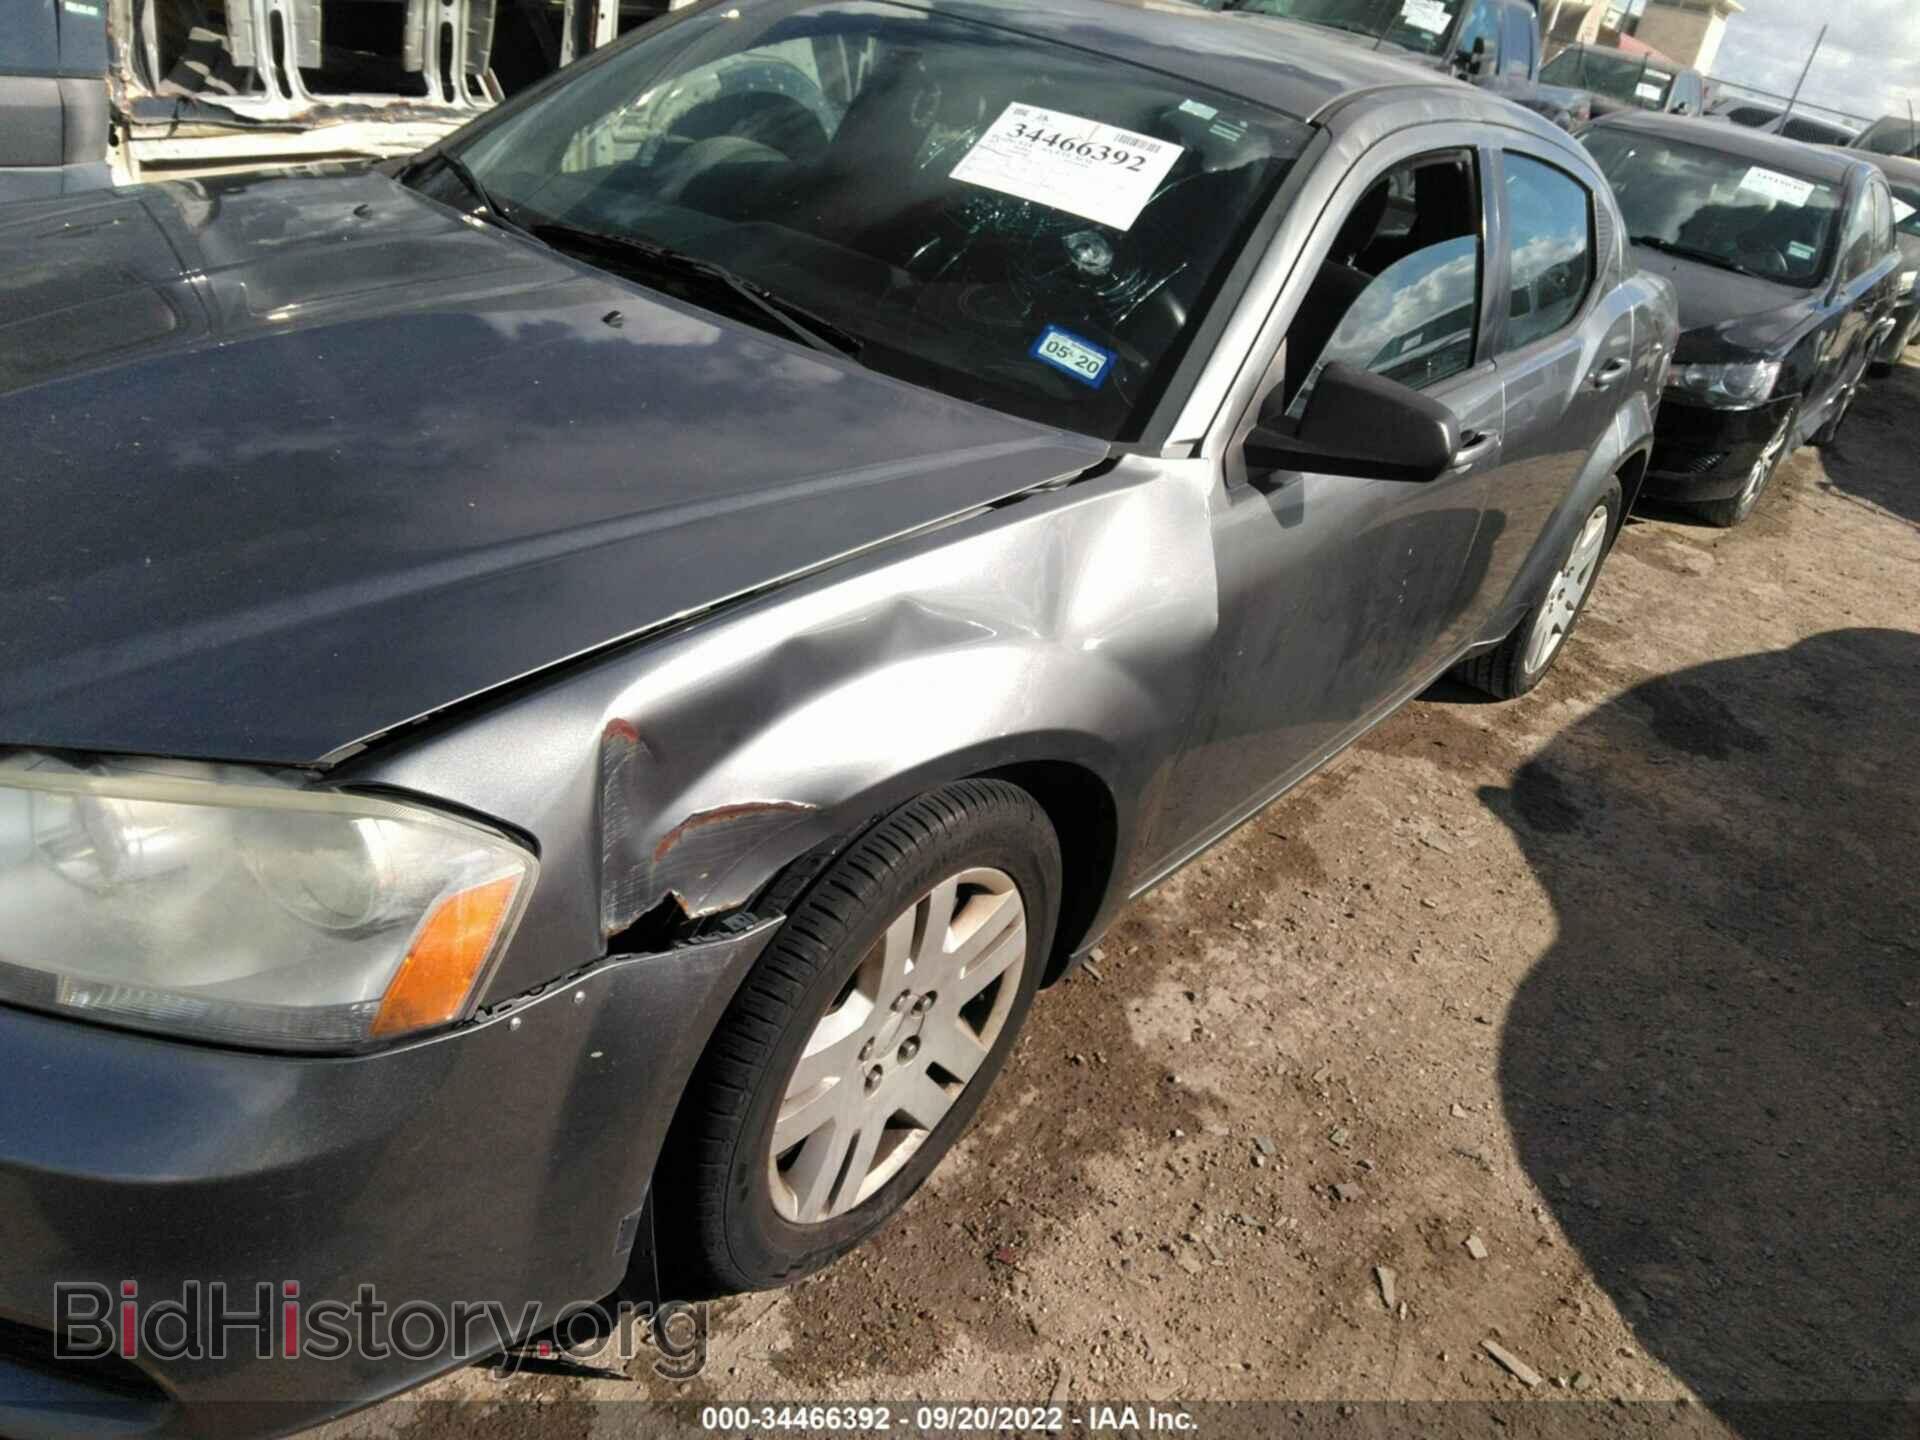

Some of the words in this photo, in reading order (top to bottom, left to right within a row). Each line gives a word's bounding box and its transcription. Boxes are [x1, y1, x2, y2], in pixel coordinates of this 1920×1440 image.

[1006, 123, 1146, 171] 34466392
[1046, 341, 1070, 359] 05
[1074, 355, 1100, 374] 20
